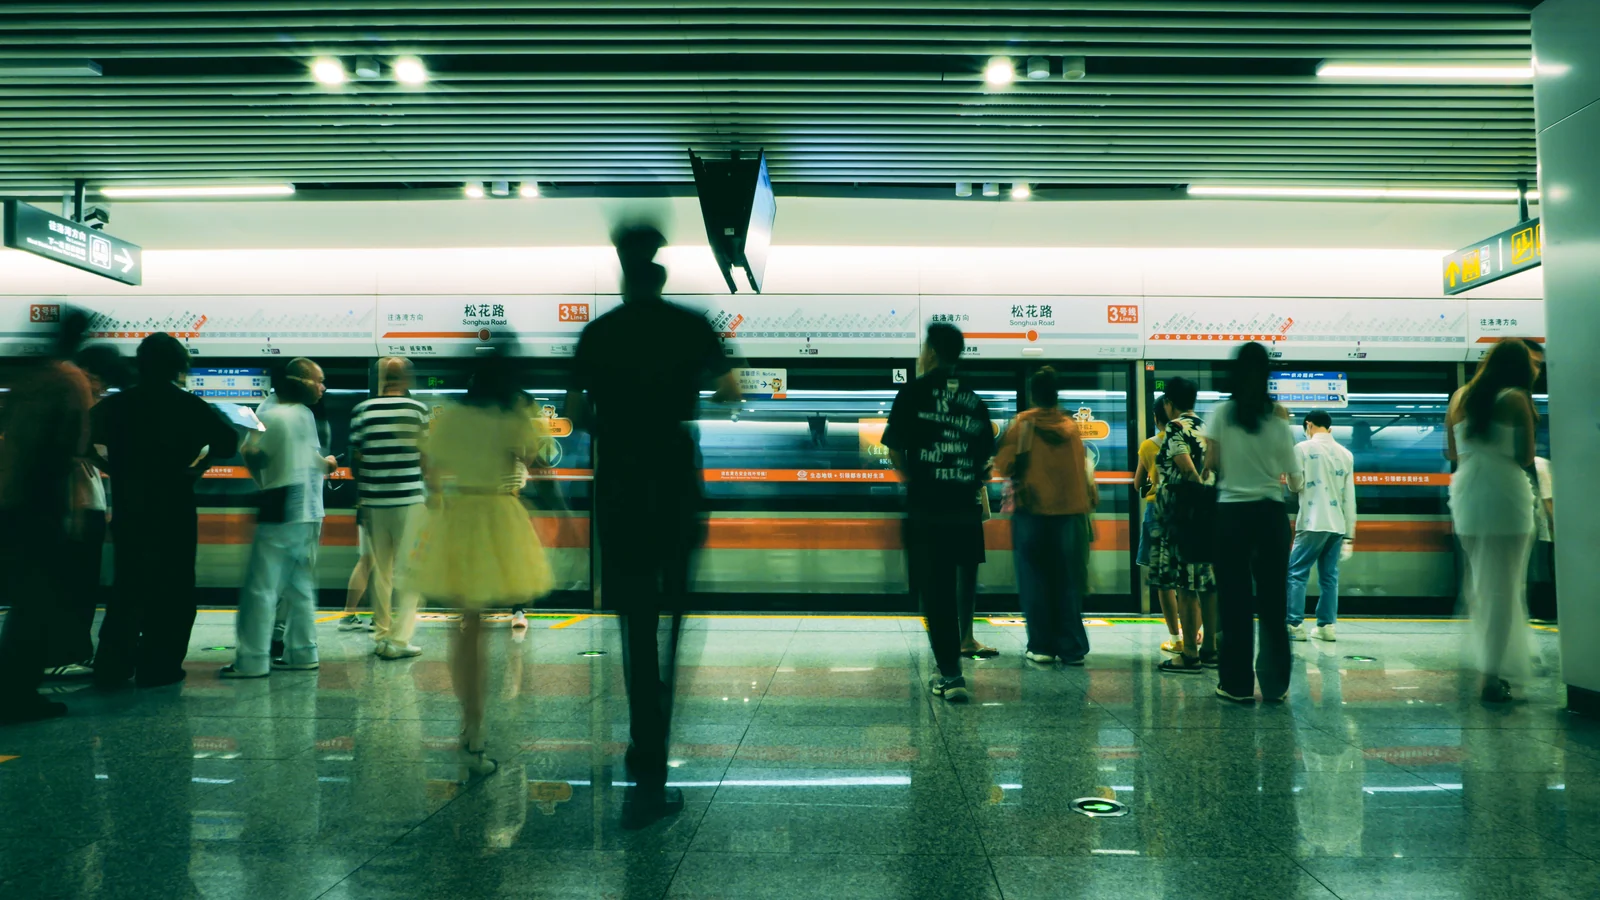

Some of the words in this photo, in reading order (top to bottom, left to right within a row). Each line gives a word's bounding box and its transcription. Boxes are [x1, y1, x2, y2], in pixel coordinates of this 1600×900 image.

[387, 313, 424, 321] 往洛湾方向
[464, 304, 505, 317] 松花路
[560, 305, 588, 320] 3号线
[1011, 304, 1053, 318] 松花路
[1109, 306, 1137, 321] 3号线
[931, 314, 970, 322] 往洛湾方向
[1480, 318, 1517, 326] 往洛湾方向
